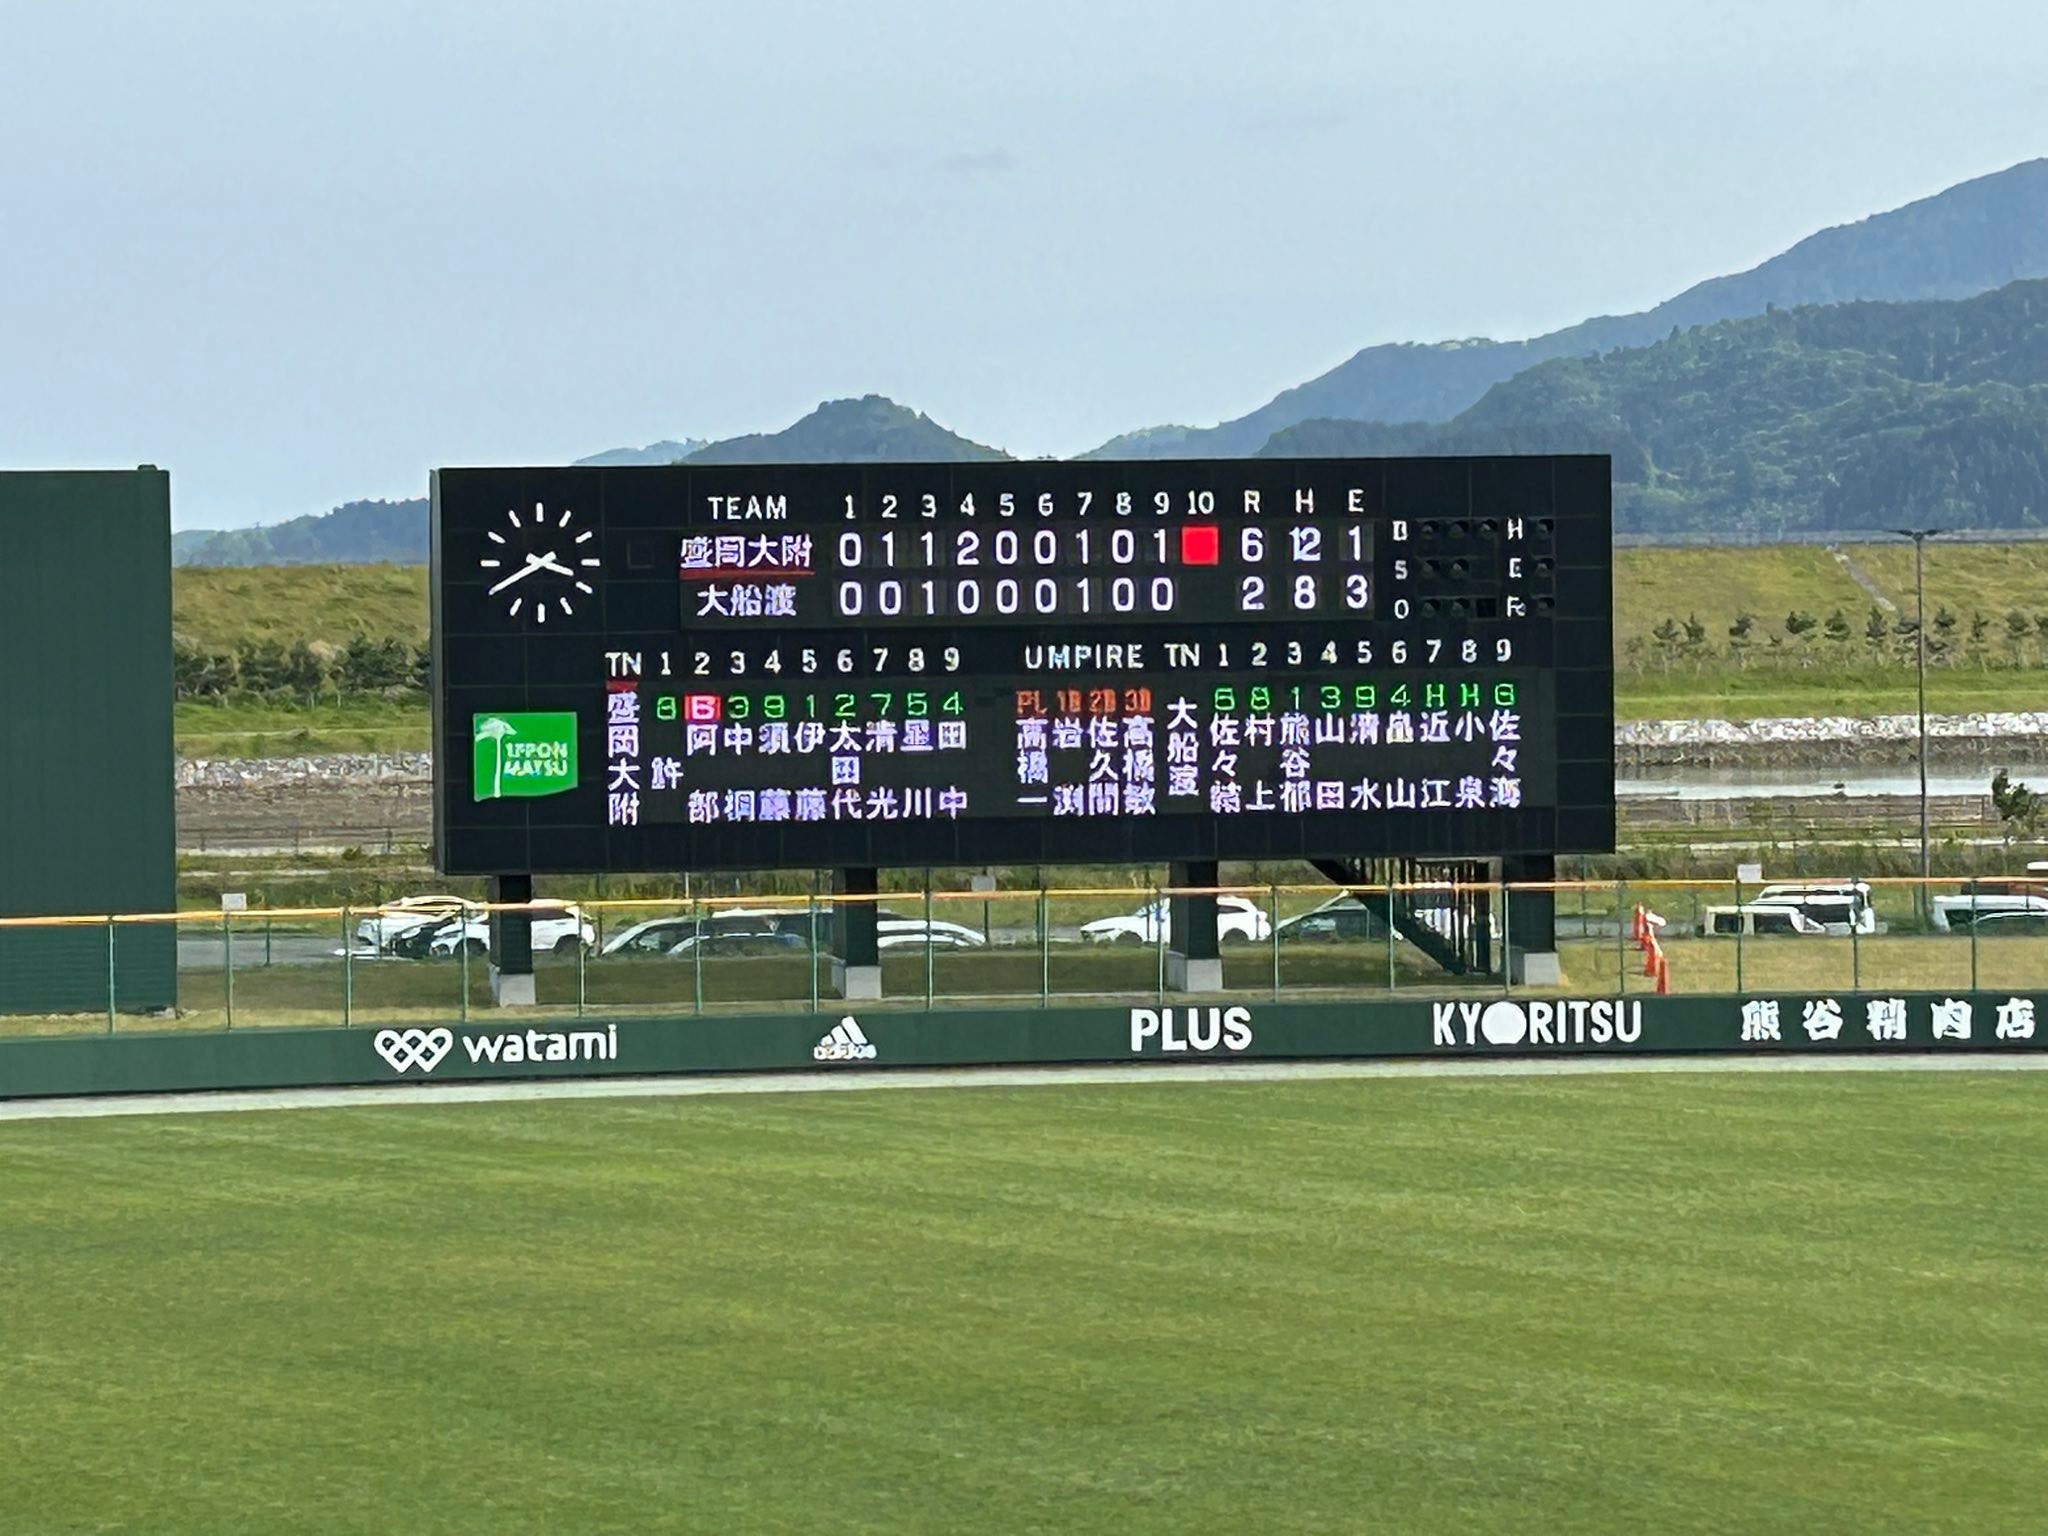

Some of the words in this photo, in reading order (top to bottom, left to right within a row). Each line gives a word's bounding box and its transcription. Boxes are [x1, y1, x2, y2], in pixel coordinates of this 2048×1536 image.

[708, 495, 786, 519] TEAM
[846, 495, 855, 519] 1
[882, 495, 897, 518] 2
[922, 495, 936, 518] 3
[960, 493, 974, 516] 4
[1000, 494, 1014, 516] 5
[1039, 493, 1053, 516] 6
[1078, 492, 1092, 515] 7
[1116, 492, 1131, 515] 8
[1154, 492, 1169, 514] 9
[1188, 491, 1214, 514] 10
[1245, 490, 1260, 513] R
[1296, 488, 1313, 513] H
[1349, 489, 1363, 512] E
[840, 533, 861, 566] 0
[882, 532, 893, 566] 1
[921, 532, 932, 565] 1
[957, 531, 979, 565] 2
[996, 531, 1017, 564] 0
[1034, 530, 1056, 564] 0
[1076, 529, 1088, 564] 1
[1112, 530, 1134, 563] 0
[1154, 529, 1165, 563] 1
[1242, 528, 1263, 561] 6
[1289, 527, 1320, 561] 12
[1349, 526, 1360, 560] 1
[1508, 518, 1522, 539] H
[1395, 560, 1407, 579] S
[1509, 558, 1521, 578] E
[697, 583, 796, 616] 大船渡
[840, 582, 862, 615] 0
[880, 581, 901, 615] 0
[922, 581, 934, 614] 1
[958, 580, 979, 614] 0
[997, 579, 1018, 613] 0
[1035, 579, 1056, 613] 0
[1077, 578, 1089, 612] 1
[1113, 578, 1134, 611] 0
[1152, 578, 1173, 611] 0
[1243, 576, 1264, 610] 2
[1294, 575, 1315, 609] 8
[1347, 575, 1367, 608] 3
[605, 652, 641, 676] TN
[662, 652, 671, 675] 1
[695, 652, 709, 674] 2
[731, 651, 745, 674] 3
[765, 650, 781, 673] 4
[803, 650, 817, 673] 5
[837, 650, 853, 672] 6
[874, 648, 888, 671] 7
[909, 648, 924, 671] 8
[945, 647, 959, 671] 9
[1025, 644, 1143, 669] UMPIRE
[1164, 644, 1199, 667] TN
[1220, 644, 1228, 666] 1
[1252, 643, 1267, 666] 2
[1288, 642, 1301, 664] 3
[1321, 641, 1337, 663] 4
[1358, 641, 1372, 663] 5
[1392, 641, 1406, 663] 6
[1427, 639, 1441, 662] 7
[1462, 639, 1477, 662] 8
[1497, 639, 1511, 661] 9
[728, 696, 749, 718] 3
[764, 695, 785, 718] 9
[807, 695, 814, 718] 1
[835, 694, 856, 717] 2
[871, 693, 891, 715] 7
[906, 693, 927, 717] 5
[943, 692, 963, 715] 4
[1292, 687, 1299, 709] 1
[1321, 686, 1341, 708] 3
[1391, 684, 1411, 707] 4
[1426, 684, 1444, 708] H
[1461, 684, 1479, 707] H
[1087, 716, 1118, 815] 佐久間
[1167, 697, 1199, 795] 大船渡
[1244, 713, 1275, 810] 村上
[1316, 713, 1344, 809] 山田
[1350, 712, 1381, 810] 清水
[1420, 710, 1451, 808] 近江
[1455, 711, 1485, 808] 小泉
[687, 724, 719, 823] 阿部
[759, 723, 791, 821] 須藤
[794, 722, 827, 820] 伊藤
[830, 720, 862, 819] 太田代
[900, 720, 933, 818] 星川
[939, 721, 967, 819] 田中
[1132, 1007, 1251, 1051] PLUS
[1434, 1001, 1641, 1045] KYORITSU
[1741, 998, 2035, 1040] 熊谷精肉店
[463, 1024, 616, 1062] watami
